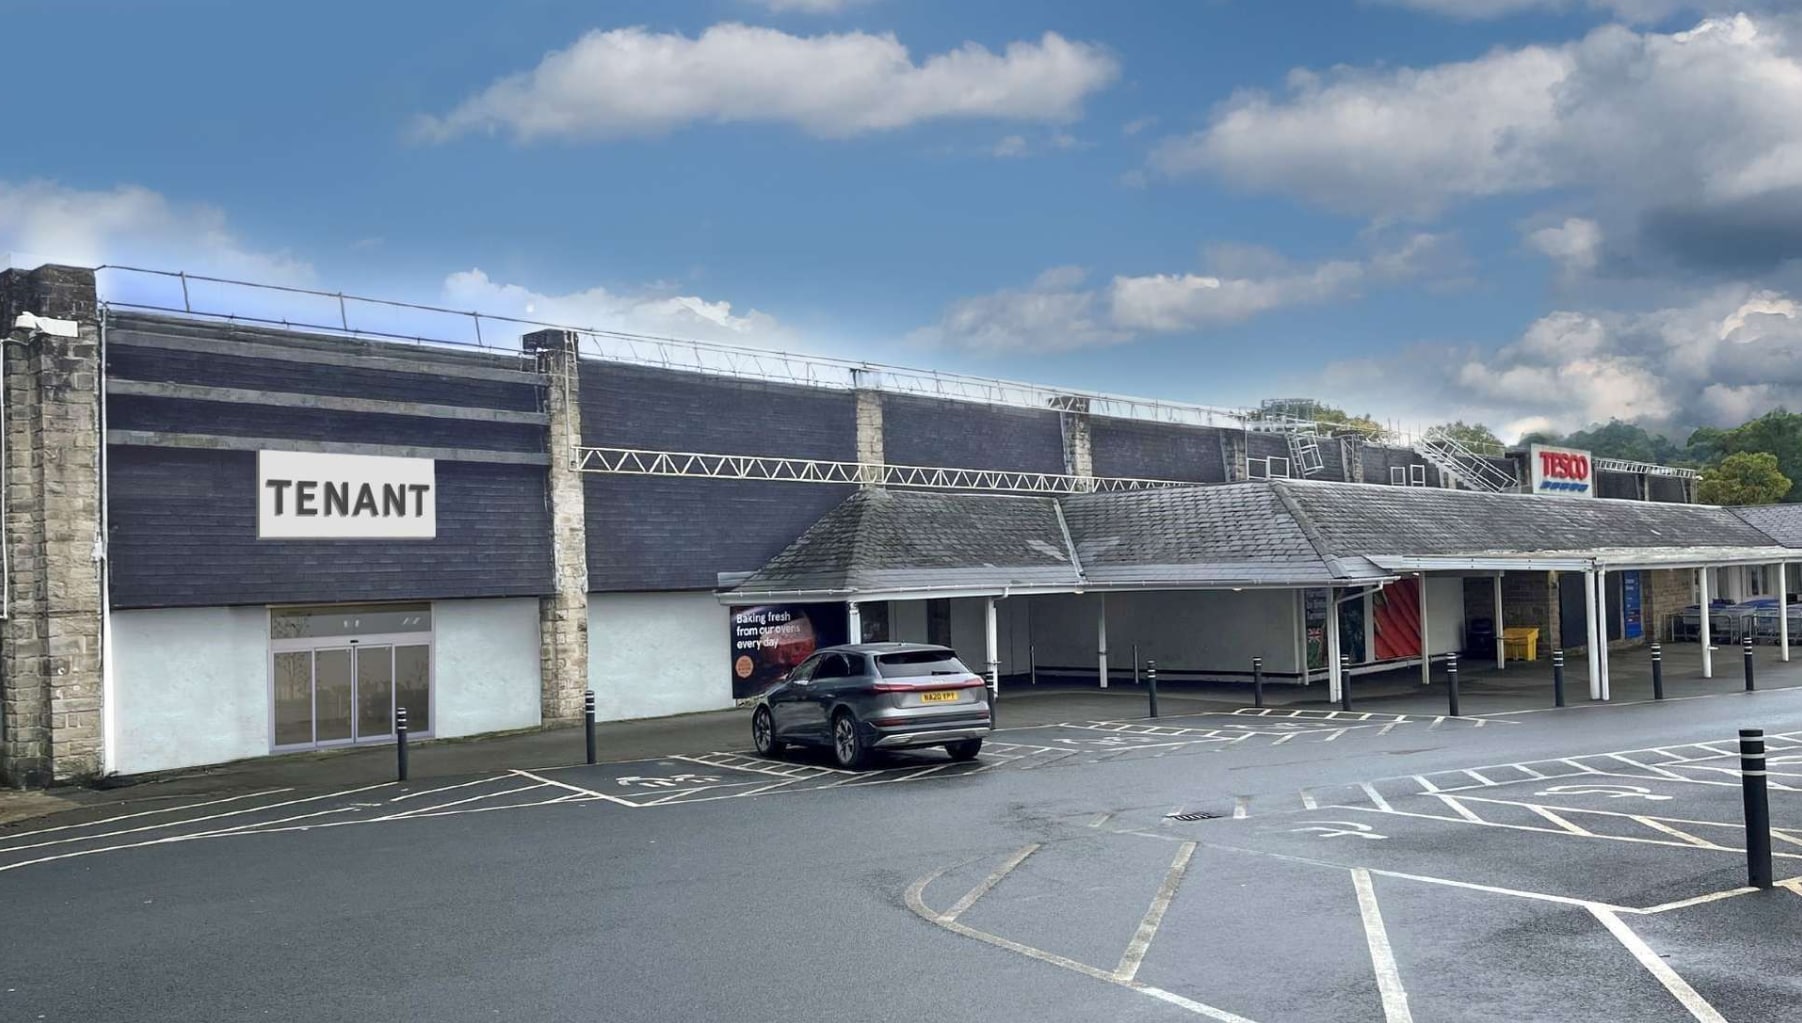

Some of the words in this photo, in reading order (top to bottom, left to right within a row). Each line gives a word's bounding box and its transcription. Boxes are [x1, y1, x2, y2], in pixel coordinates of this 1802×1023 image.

[1539, 451, 1588, 480] TESCO
[265, 479, 430, 518] TENANT
[736, 612, 766, 625] Baking
[768, 611, 791, 622] fresh
[736, 625, 758, 636] from
[759, 626, 775, 635] our
[775, 624, 800, 634] ovens
[736, 639, 761, 651] every
[762, 637, 779, 649] day
